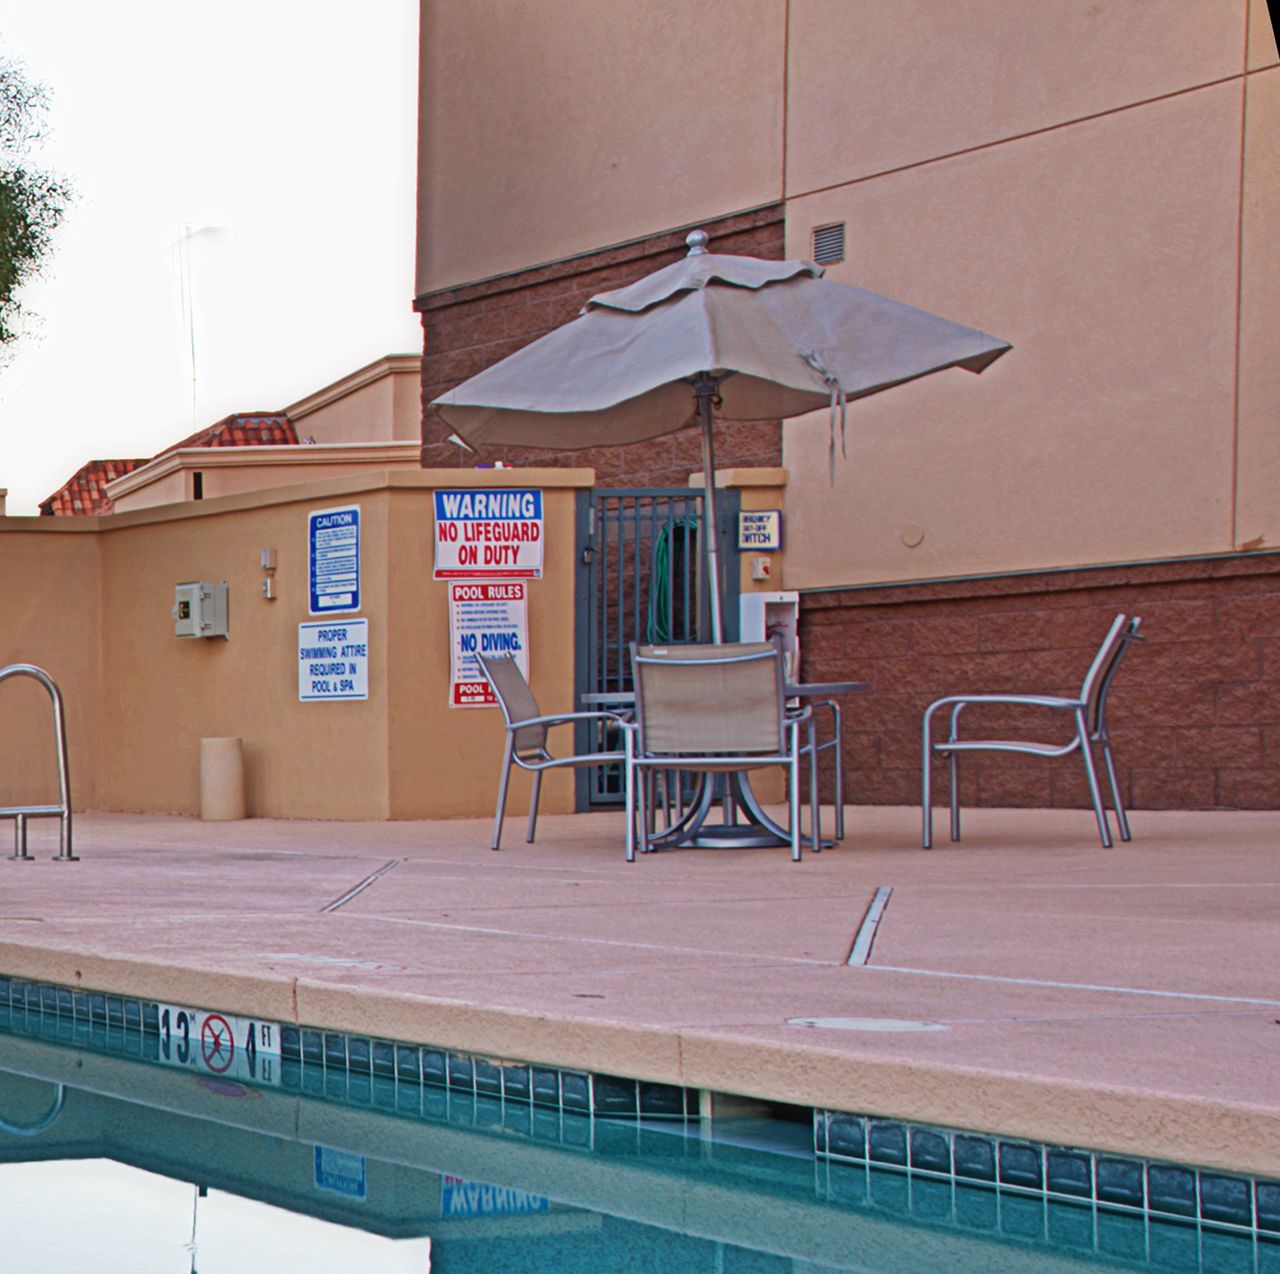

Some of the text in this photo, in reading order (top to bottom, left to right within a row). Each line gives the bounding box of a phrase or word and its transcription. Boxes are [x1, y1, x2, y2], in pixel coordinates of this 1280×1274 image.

[443, 493, 535, 518] WARNING
[316, 513, 353, 528] CAUTION
[438, 522, 540, 542] NO LIFEGUARD
[458, 545, 520, 565] ON DUTY
[455, 585, 522, 599] POOL RULES
[318, 628, 347, 642] PROPER
[461, 632, 522, 652] NO DIVING.
[300, 644, 366, 660] SWIMMING ATTIRE
[310, 662, 357, 676] REQUIRED IN
[312, 680, 330, 693] POOL
[340, 679, 354, 692] SPA
[460, 684, 484, 695] POOL
